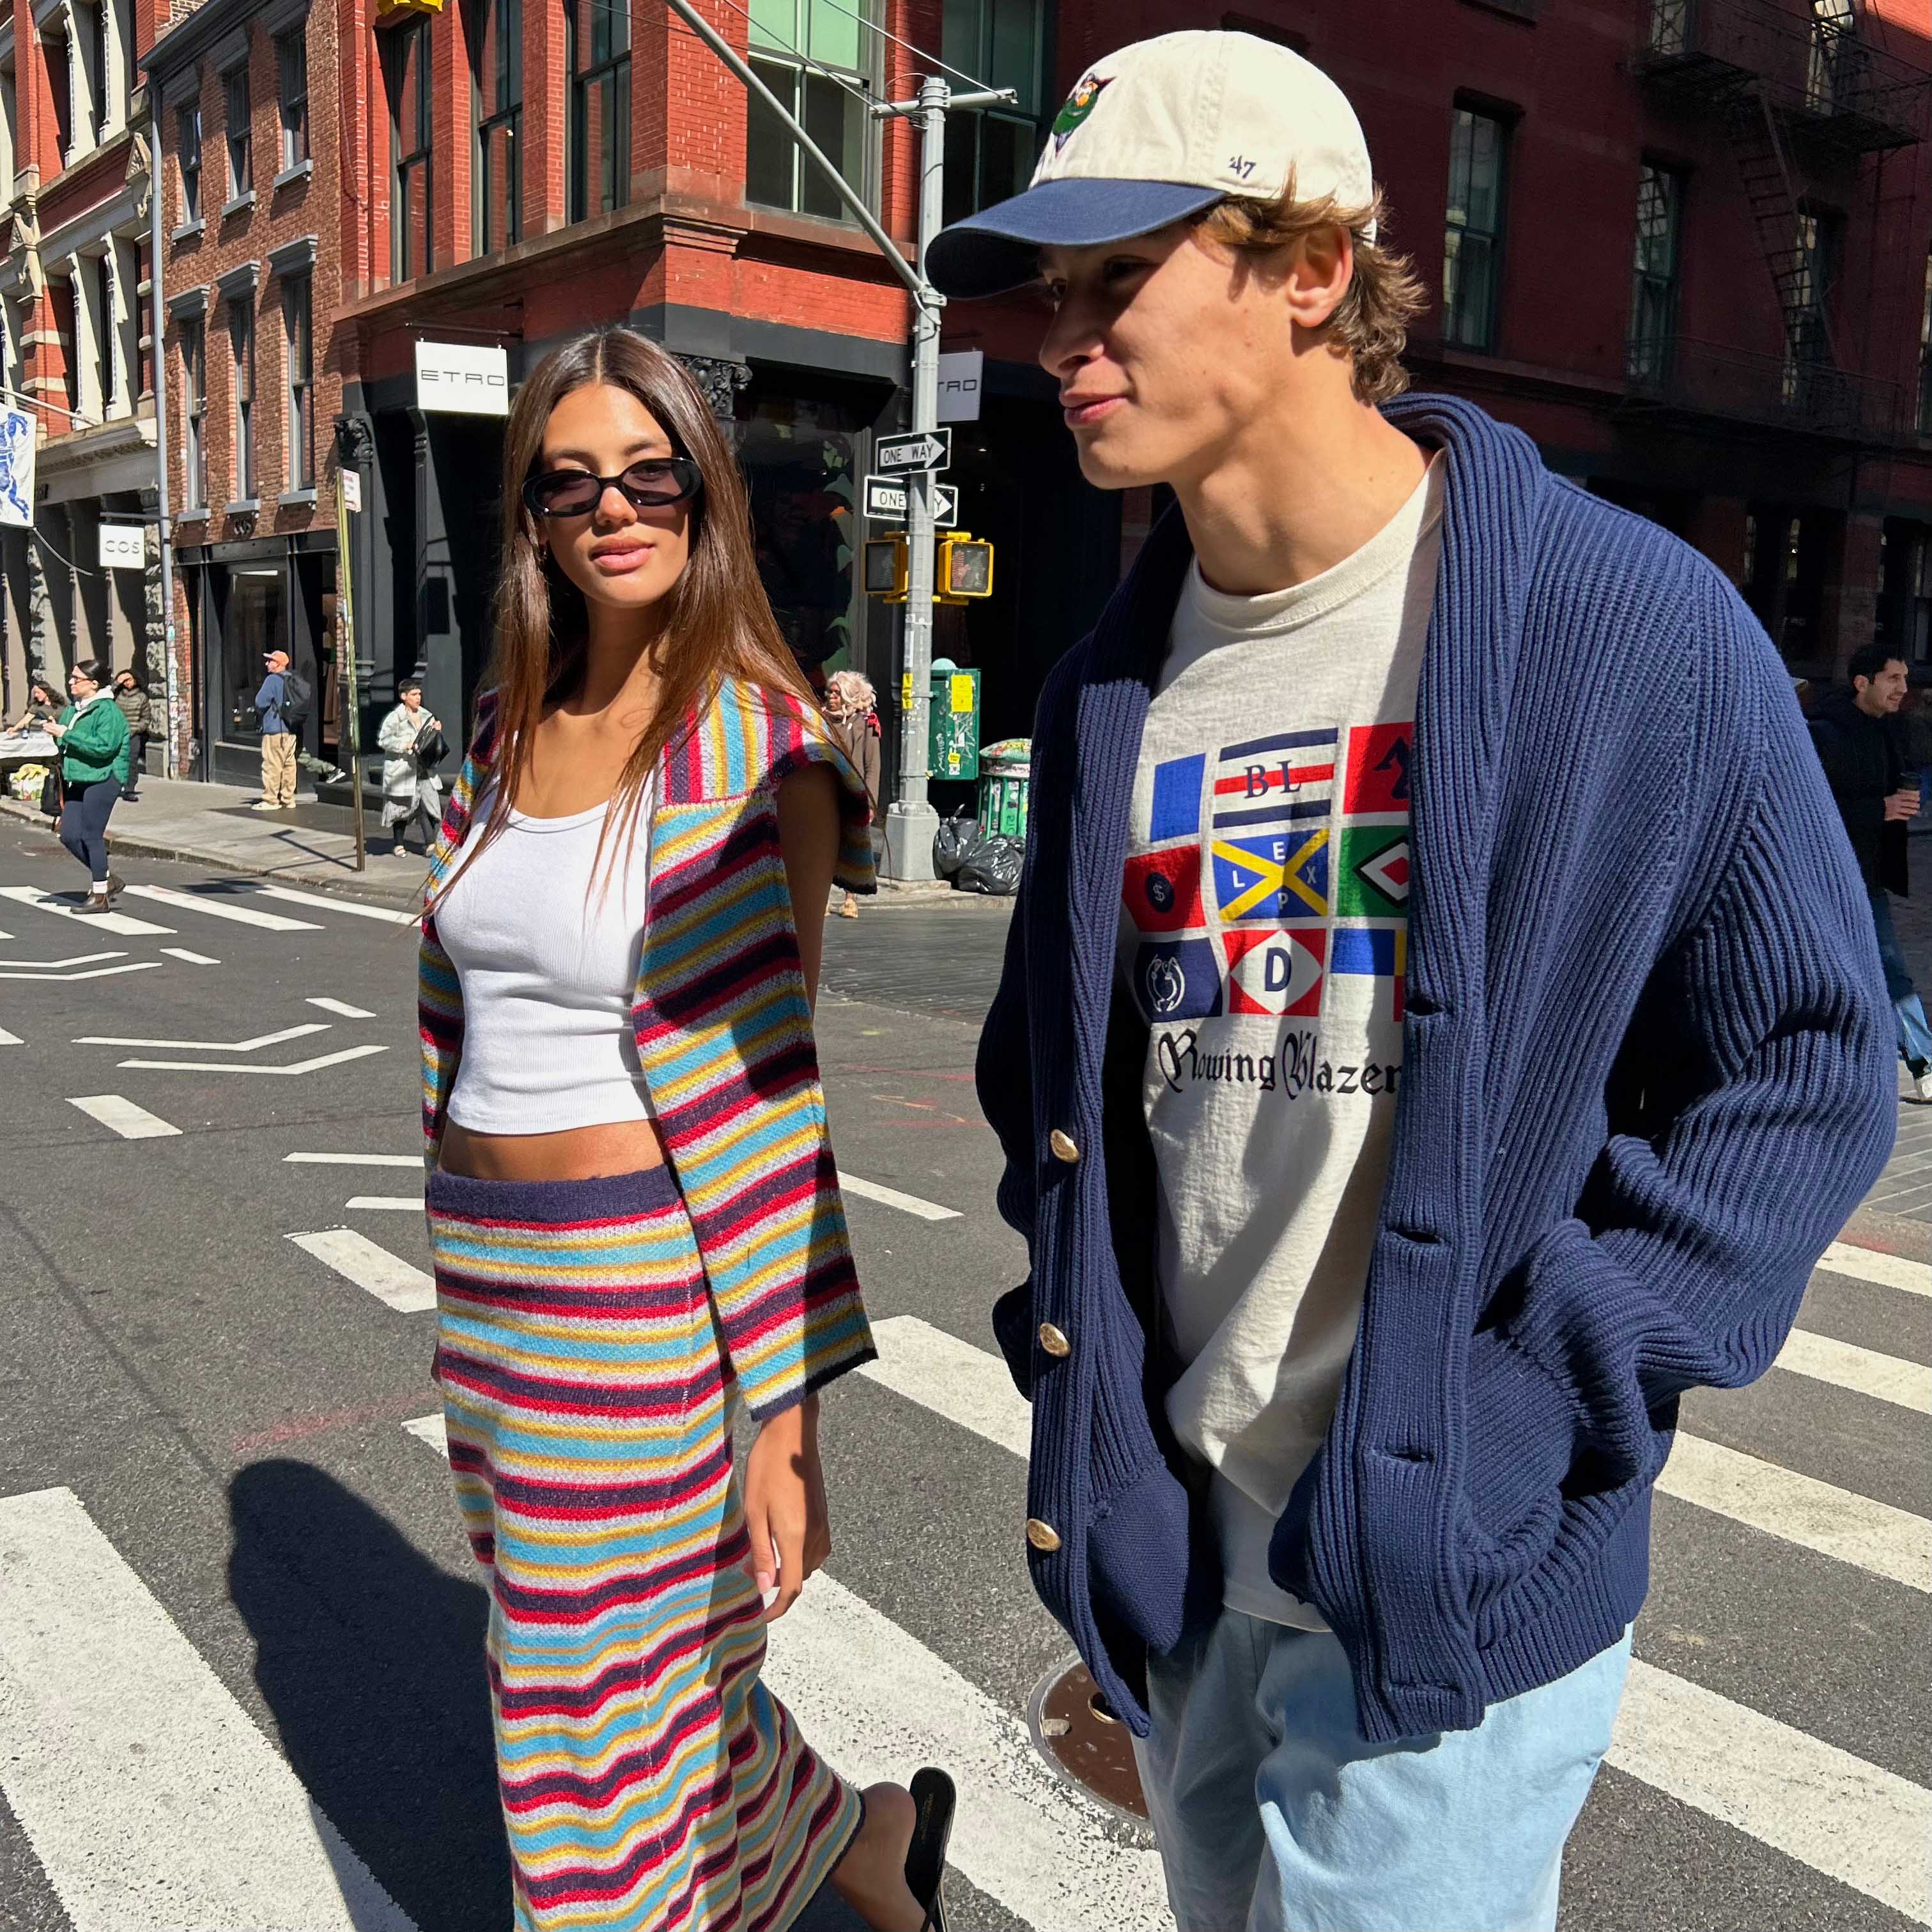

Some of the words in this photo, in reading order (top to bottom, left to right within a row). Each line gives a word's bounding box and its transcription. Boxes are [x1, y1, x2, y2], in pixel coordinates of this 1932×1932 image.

[421, 369, 505, 386] ETRO
[883, 448, 902, 464] ONE
[911, 444, 934, 460] WAY
[879, 491, 906, 507] ONE
[105, 540, 140, 554] COS
[1272, 841, 1285, 860] E
[1264, 947, 1292, 992] D
[1157, 1028, 1276, 1093] Rowing
